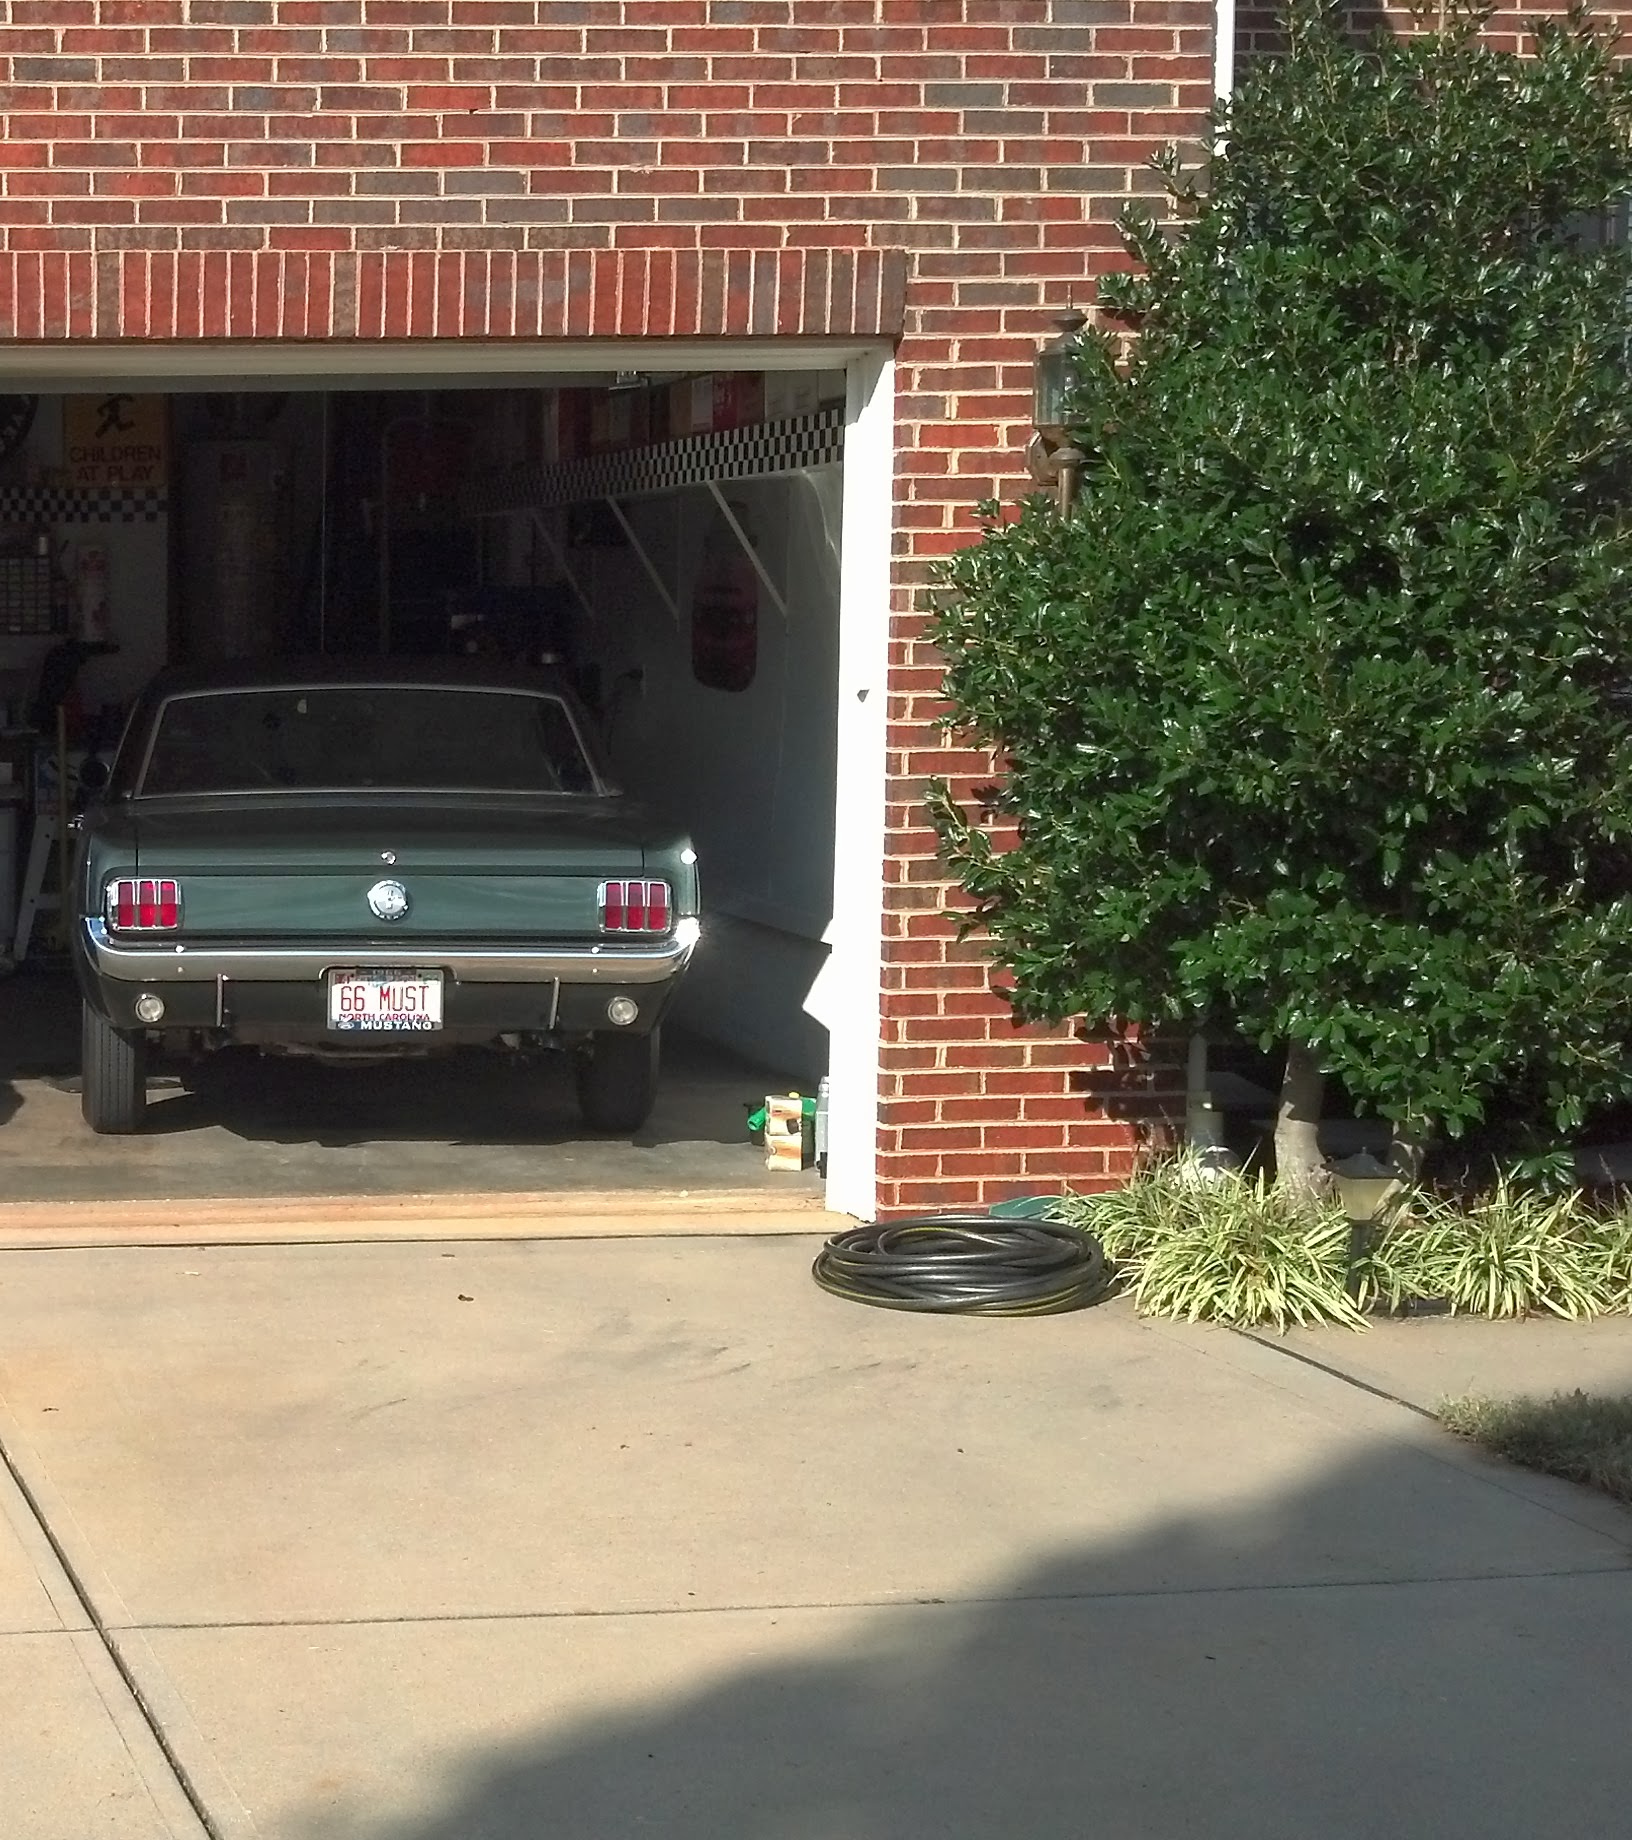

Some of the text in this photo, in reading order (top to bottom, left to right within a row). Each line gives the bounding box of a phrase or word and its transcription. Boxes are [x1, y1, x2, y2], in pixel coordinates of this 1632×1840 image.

[70, 446, 161, 463] CHILDREN
[76, 466, 154, 482] AT PLAY
[340, 985, 430, 1012] 66 MUST
[338, 1013, 430, 1021] NORTH CAROLINA
[360, 1021, 433, 1031] MUSTANG
